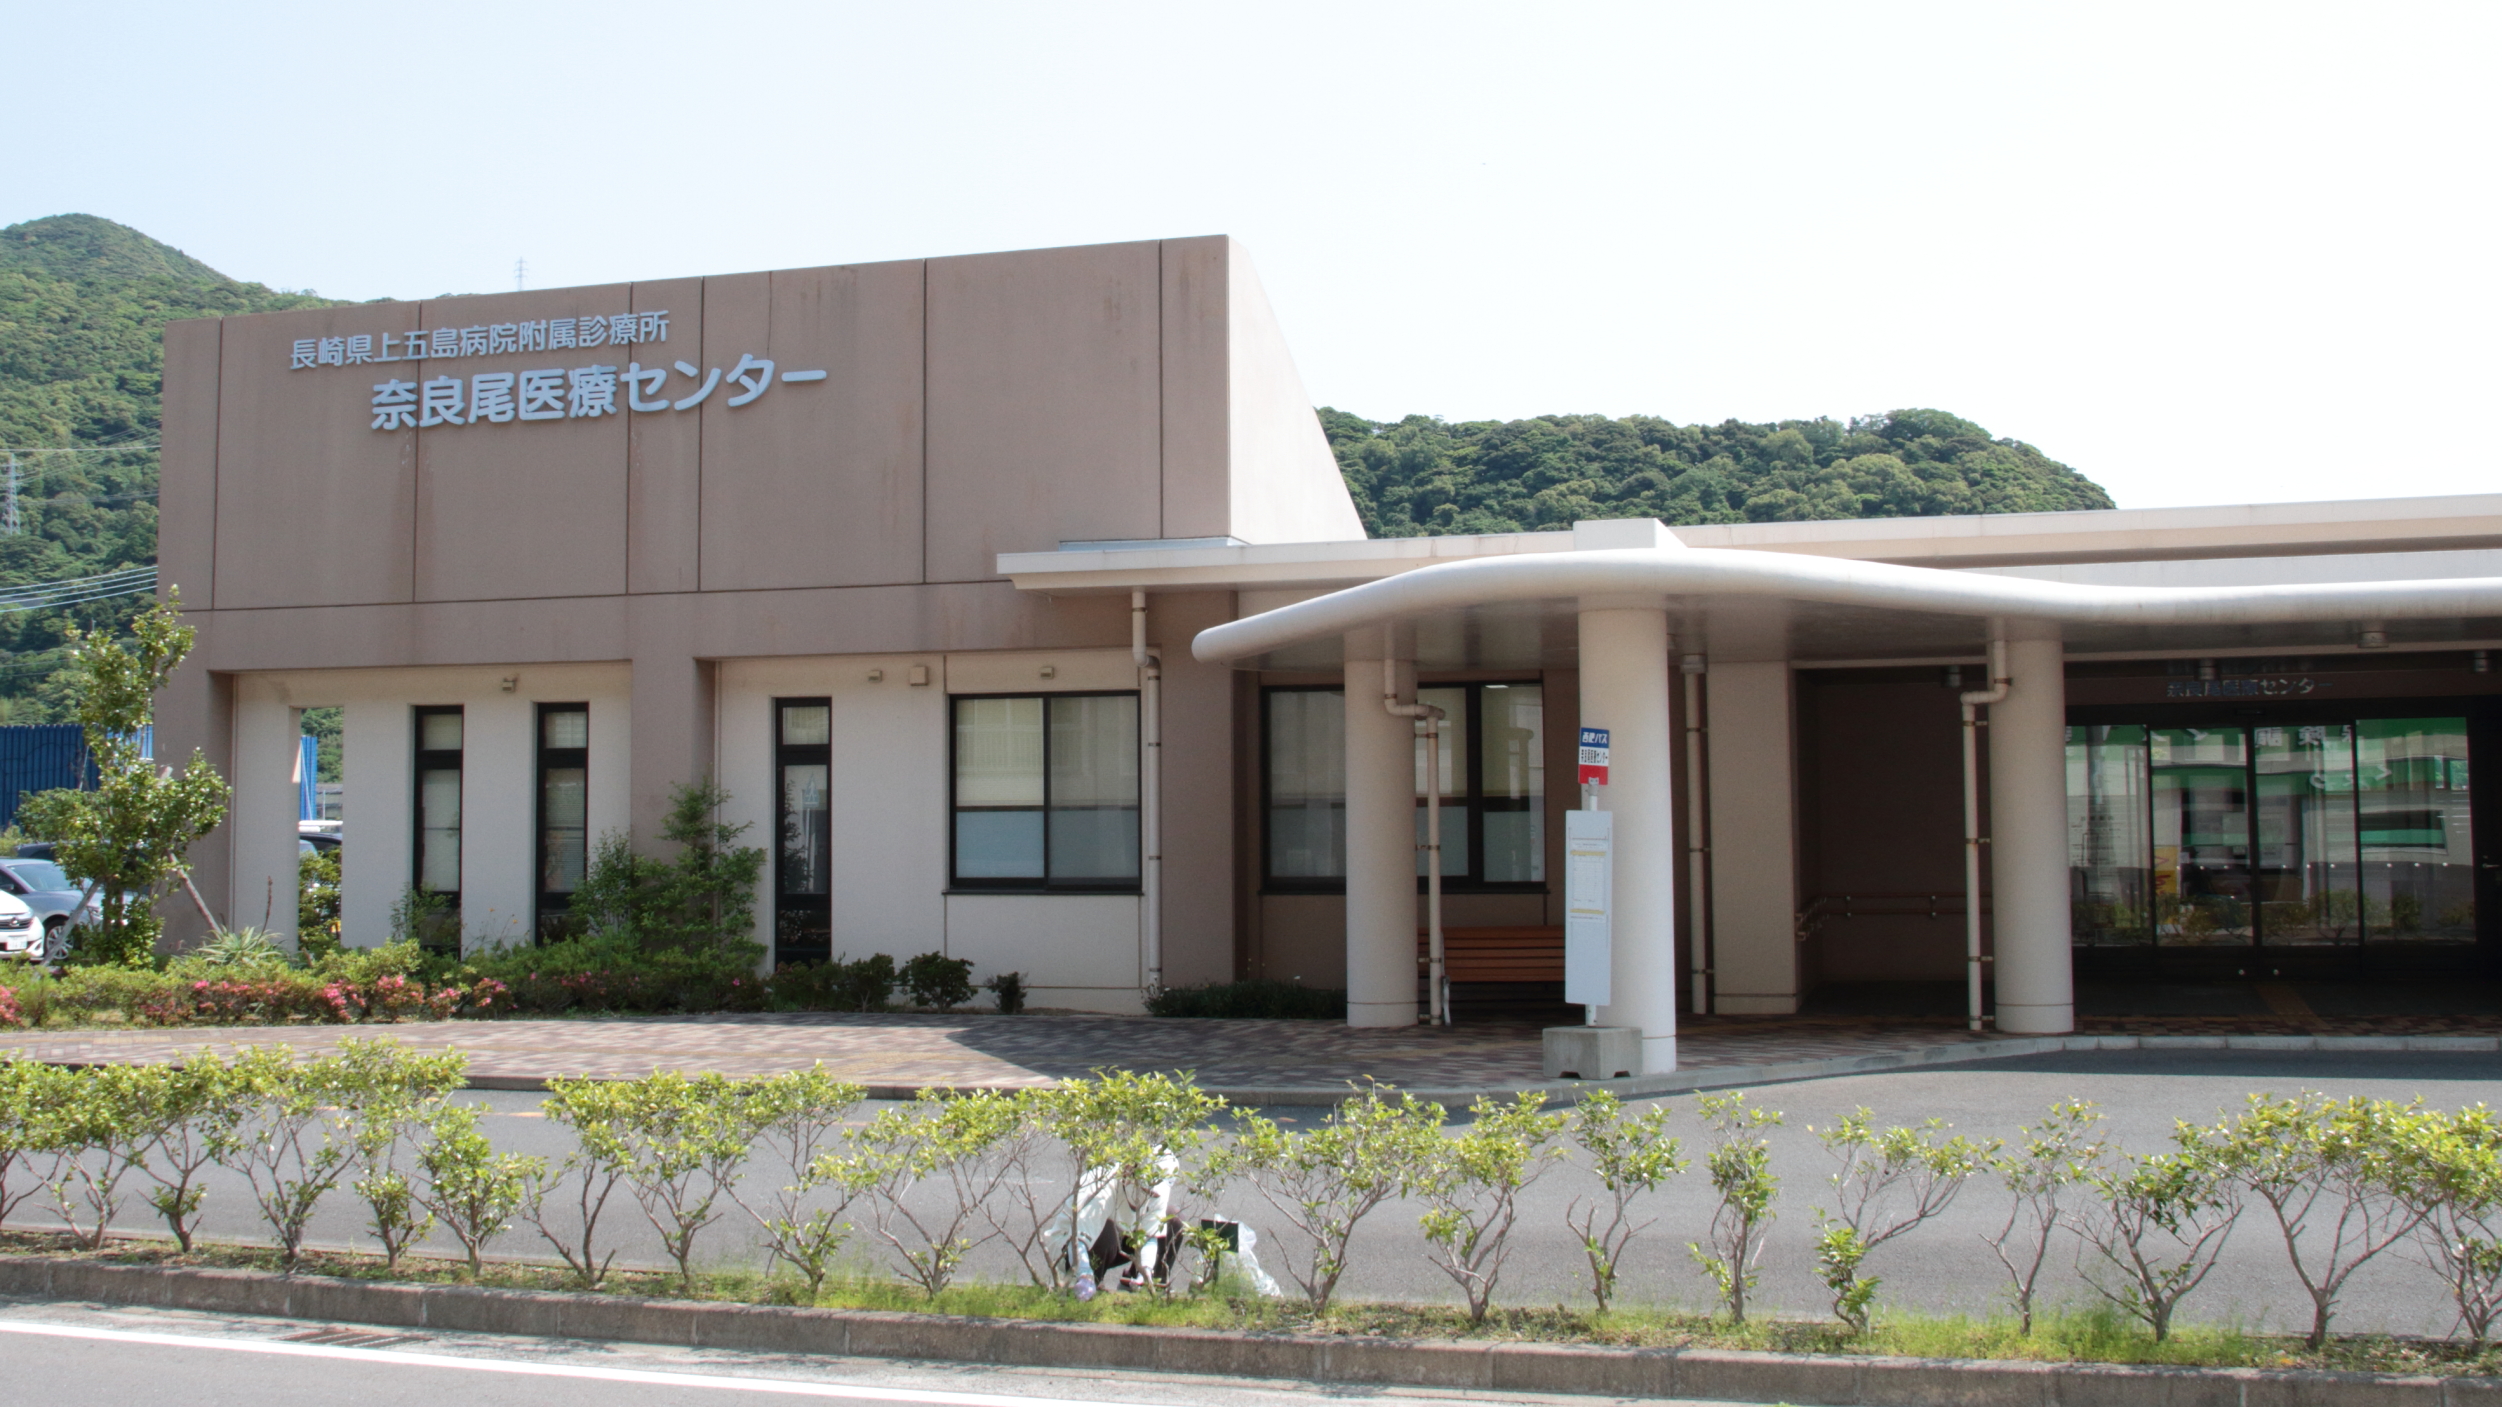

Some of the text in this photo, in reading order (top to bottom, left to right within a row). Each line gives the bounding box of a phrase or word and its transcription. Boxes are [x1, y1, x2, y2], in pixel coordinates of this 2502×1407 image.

[290, 310, 669, 370] 長崎県上五島病院附属診療所
[371, 353, 827, 430] 奈良尾医療センター
[2166, 678, 2333, 698] 奈良尾医療センター
